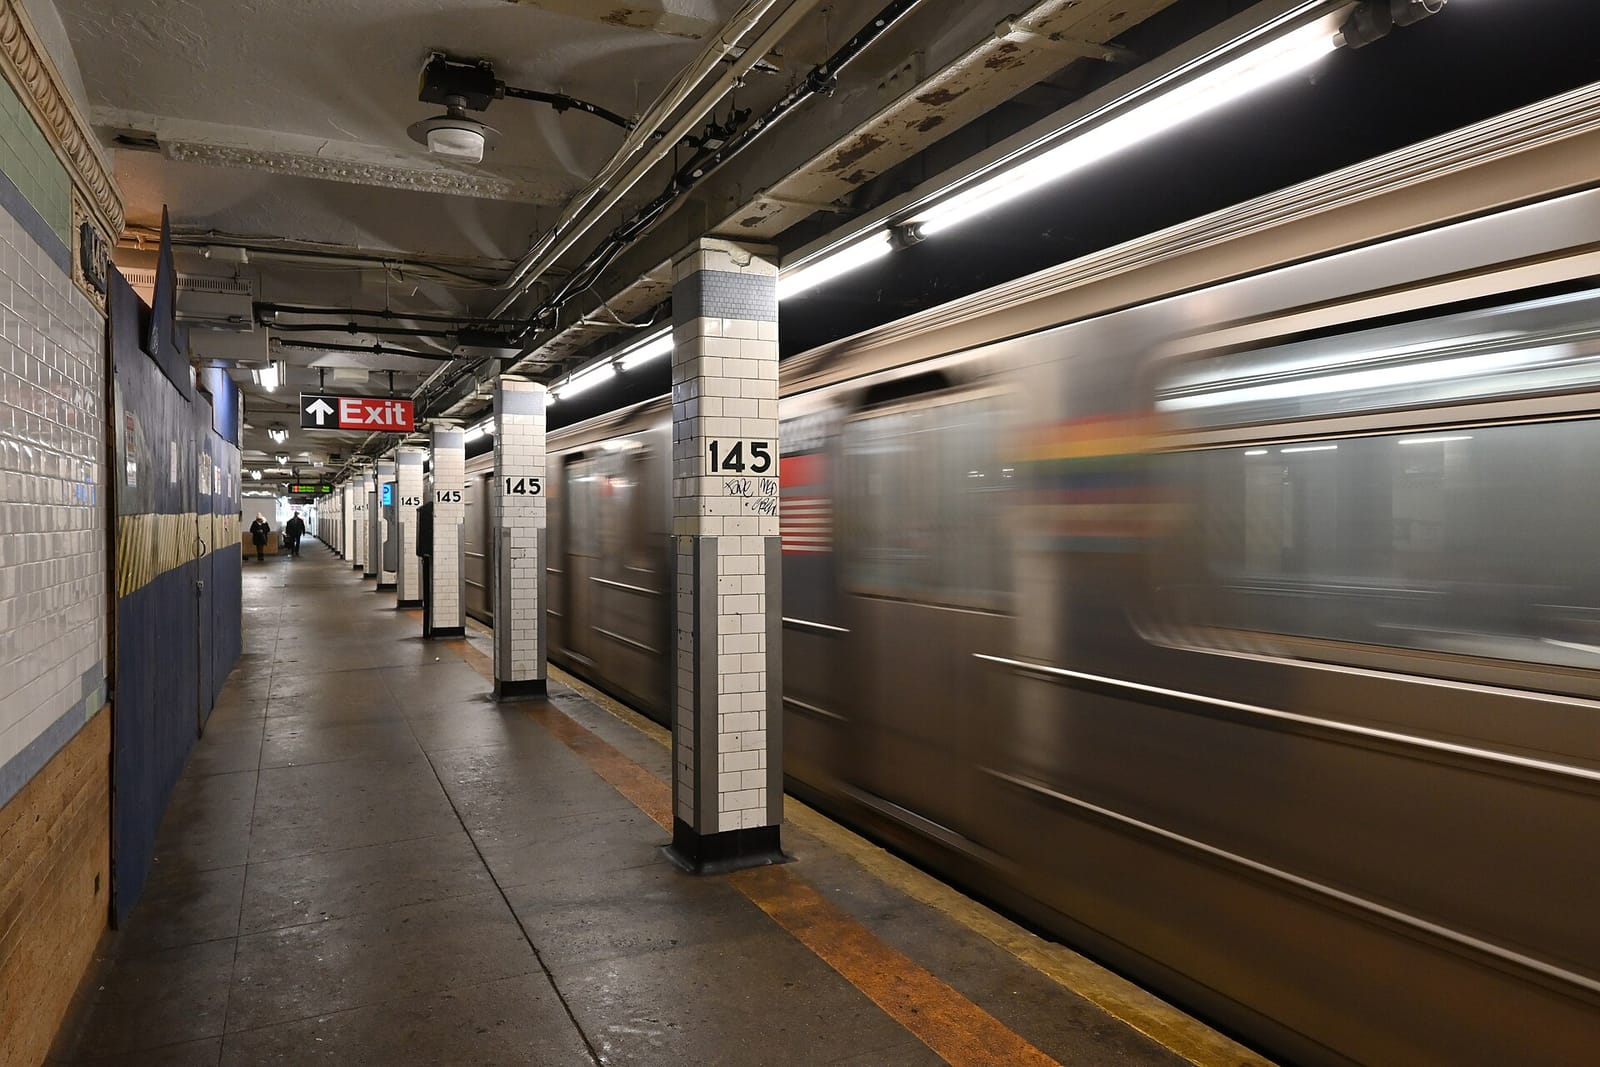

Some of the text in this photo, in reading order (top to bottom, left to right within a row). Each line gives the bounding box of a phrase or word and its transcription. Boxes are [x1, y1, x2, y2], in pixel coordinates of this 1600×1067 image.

[340, 399, 406, 426] Exit
[709, 440, 771, 473] 145
[505, 478, 541, 496] 145
[401, 497, 420, 506] 145
[436, 491, 461, 503] 145
